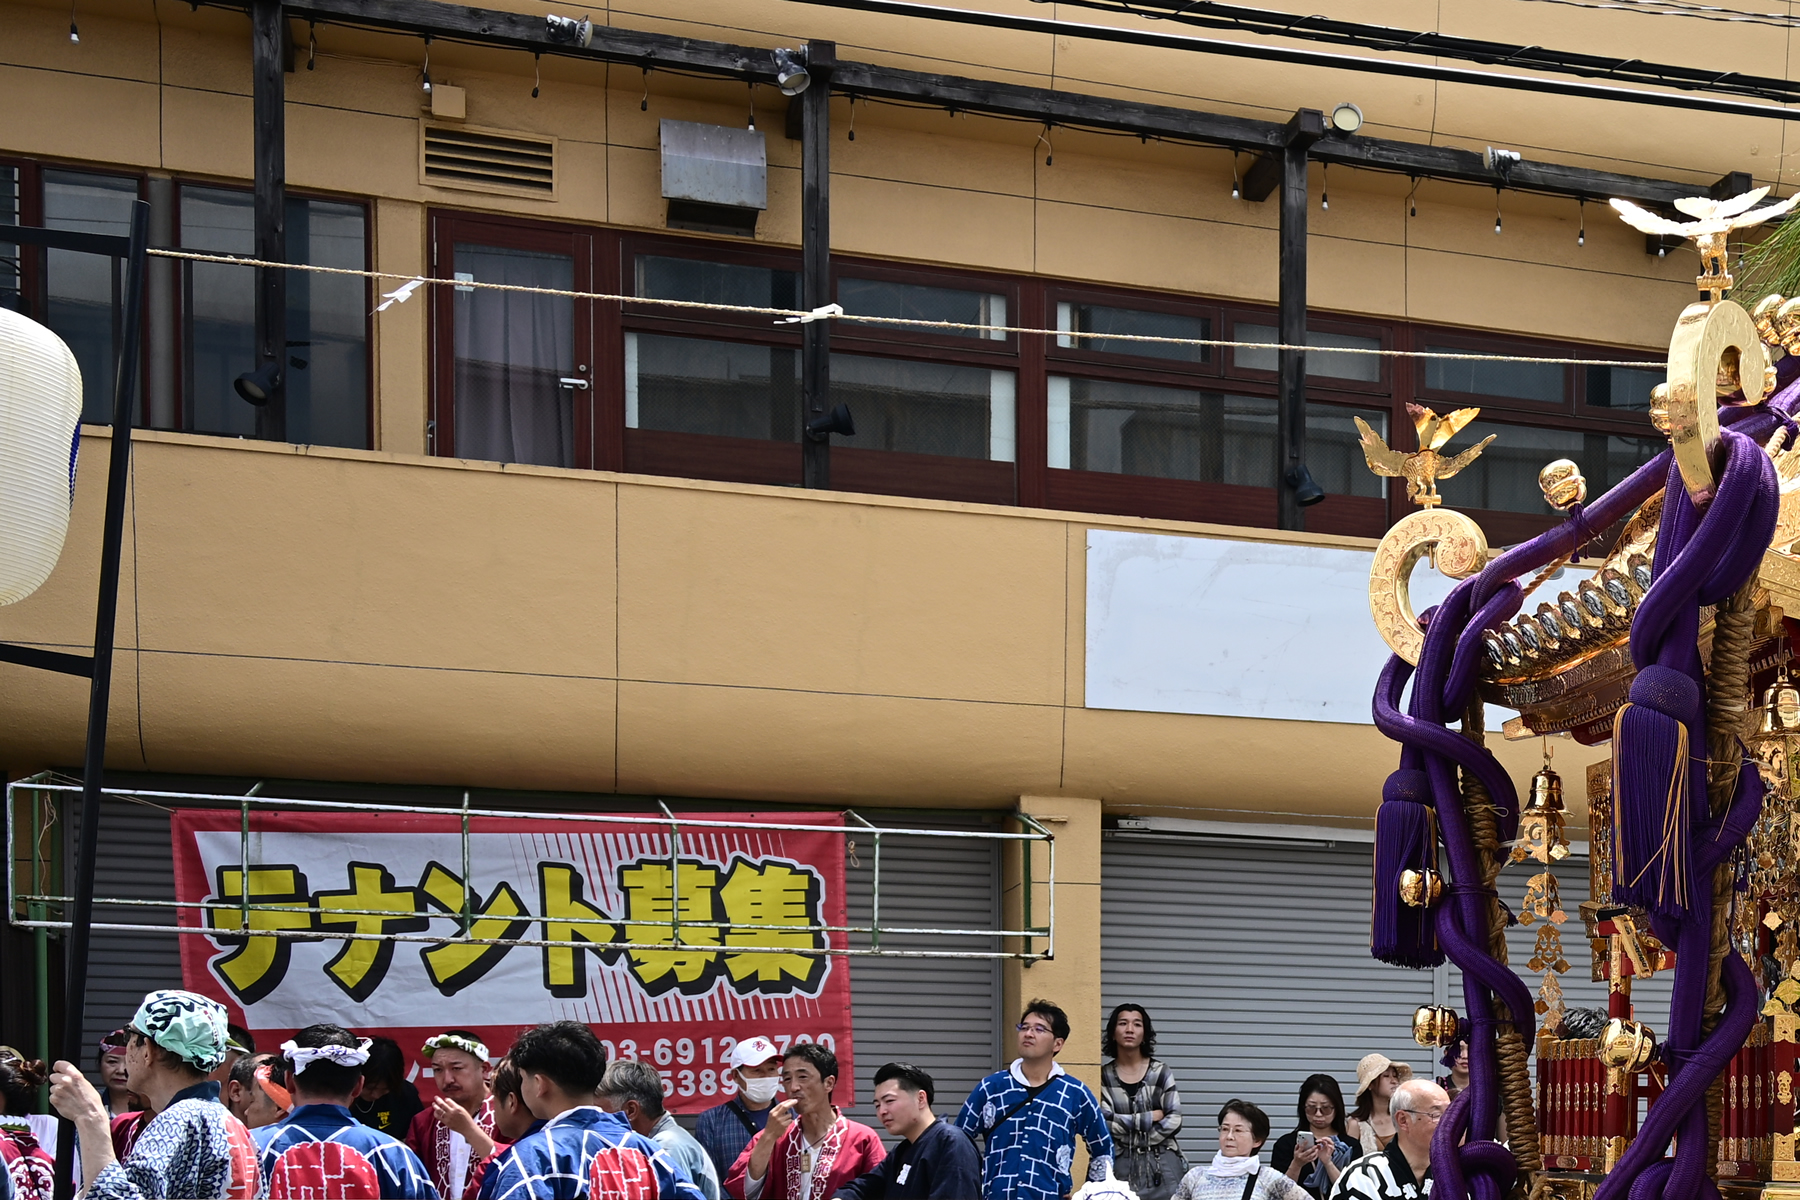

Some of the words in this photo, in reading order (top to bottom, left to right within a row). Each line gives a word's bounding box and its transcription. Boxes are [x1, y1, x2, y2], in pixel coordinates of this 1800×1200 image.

[209, 855, 828, 1005] テナント募集
